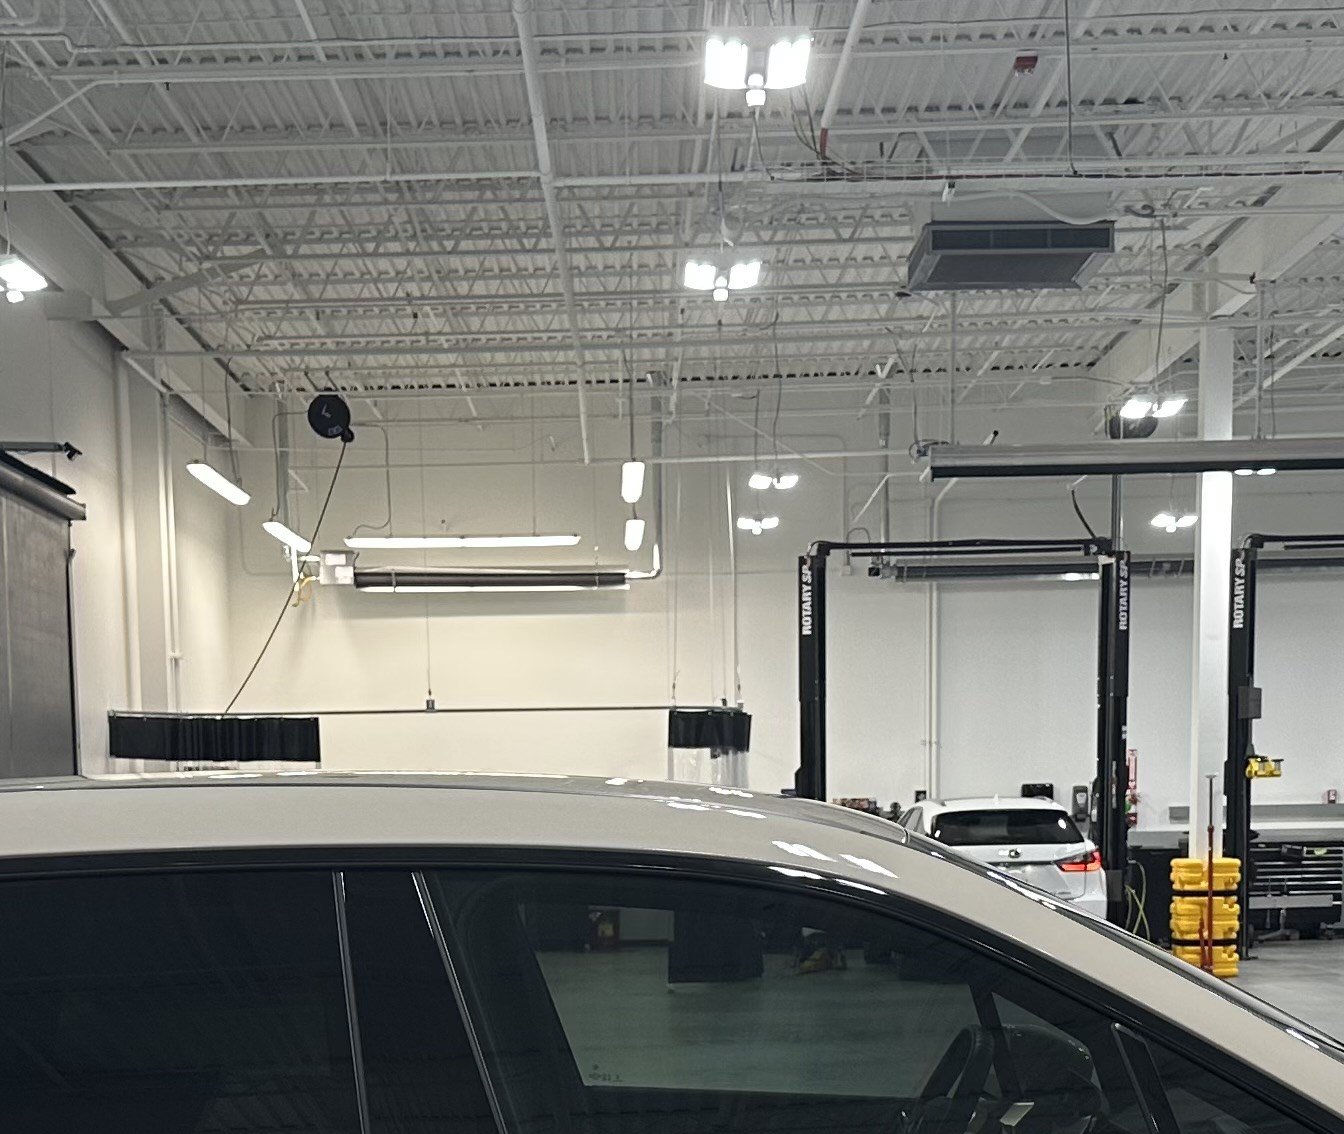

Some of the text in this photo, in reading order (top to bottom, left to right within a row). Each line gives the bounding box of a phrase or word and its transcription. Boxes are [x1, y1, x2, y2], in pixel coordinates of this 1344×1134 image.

[802, 583, 812, 635] ROTARY
[1118, 579, 1128, 630] ROTARY
[1233, 577, 1245, 628] ROTARY
